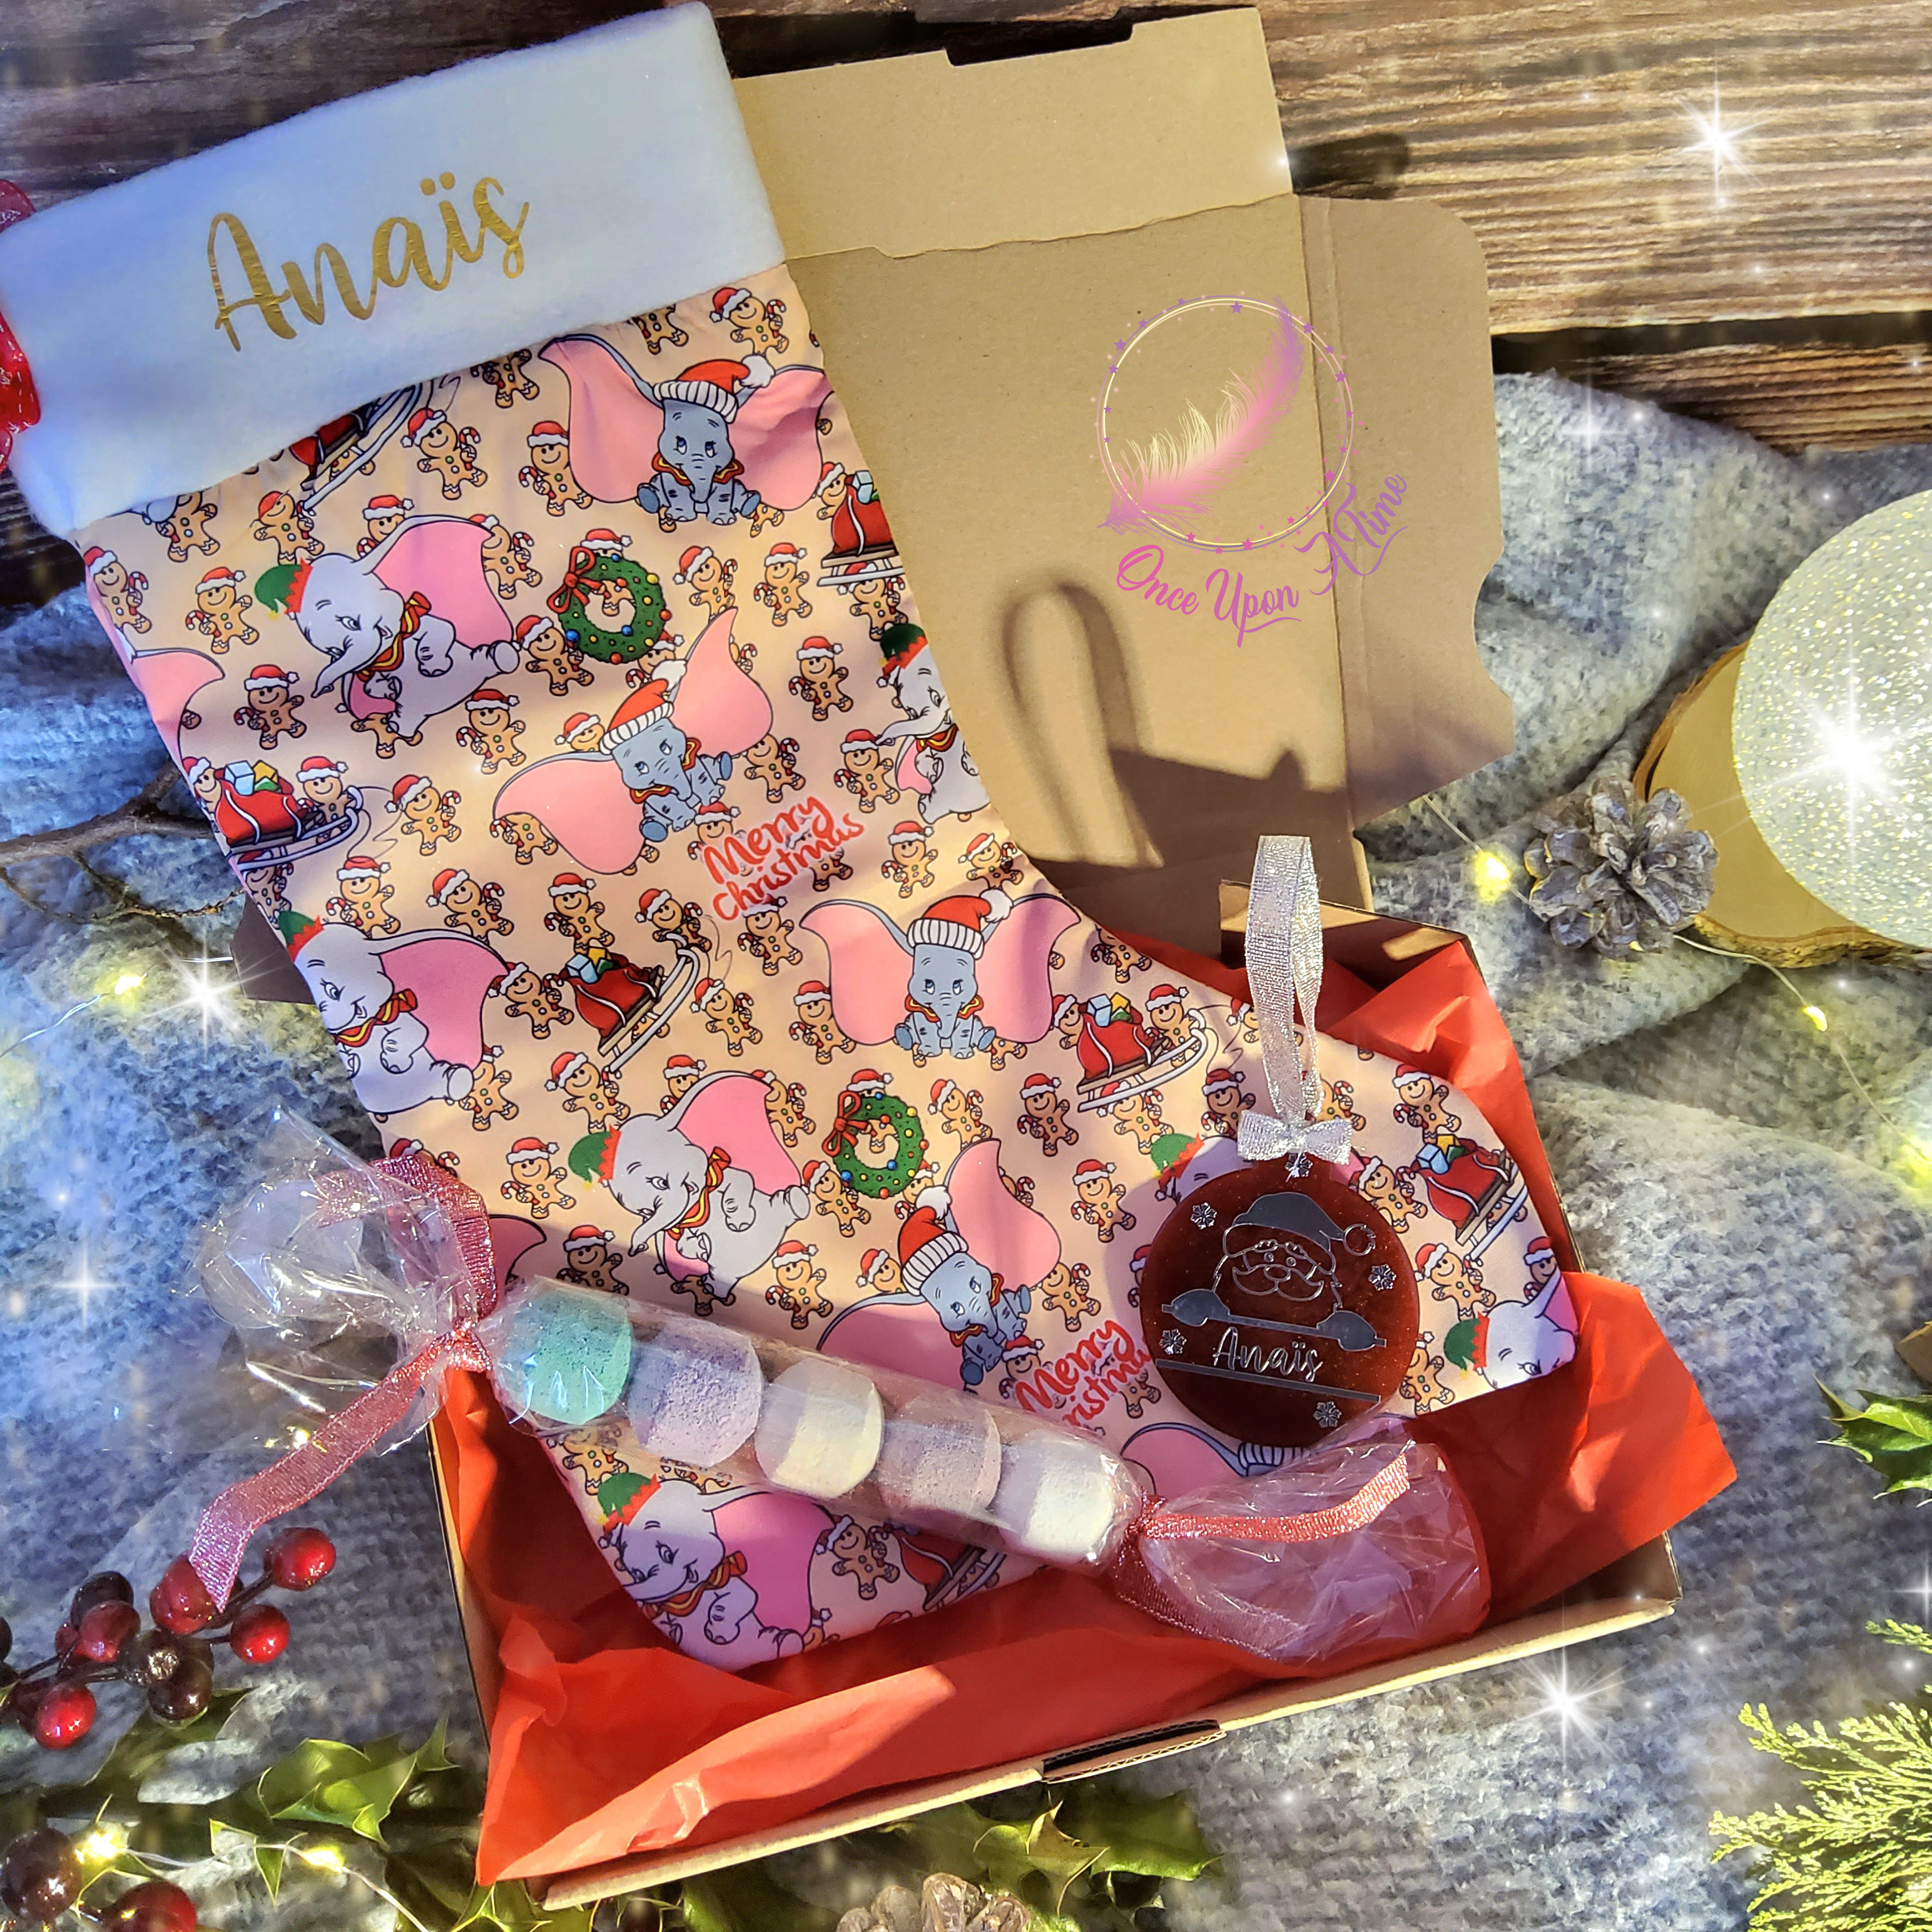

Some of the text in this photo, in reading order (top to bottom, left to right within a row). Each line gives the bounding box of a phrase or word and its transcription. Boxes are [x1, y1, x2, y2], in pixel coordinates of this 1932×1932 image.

[207, 172, 530, 352] Anaïs
[703, 796, 834, 885] Merry
[1015, 1320, 1136, 1413] Merry
[1213, 1326, 1323, 1382] Anaïs
